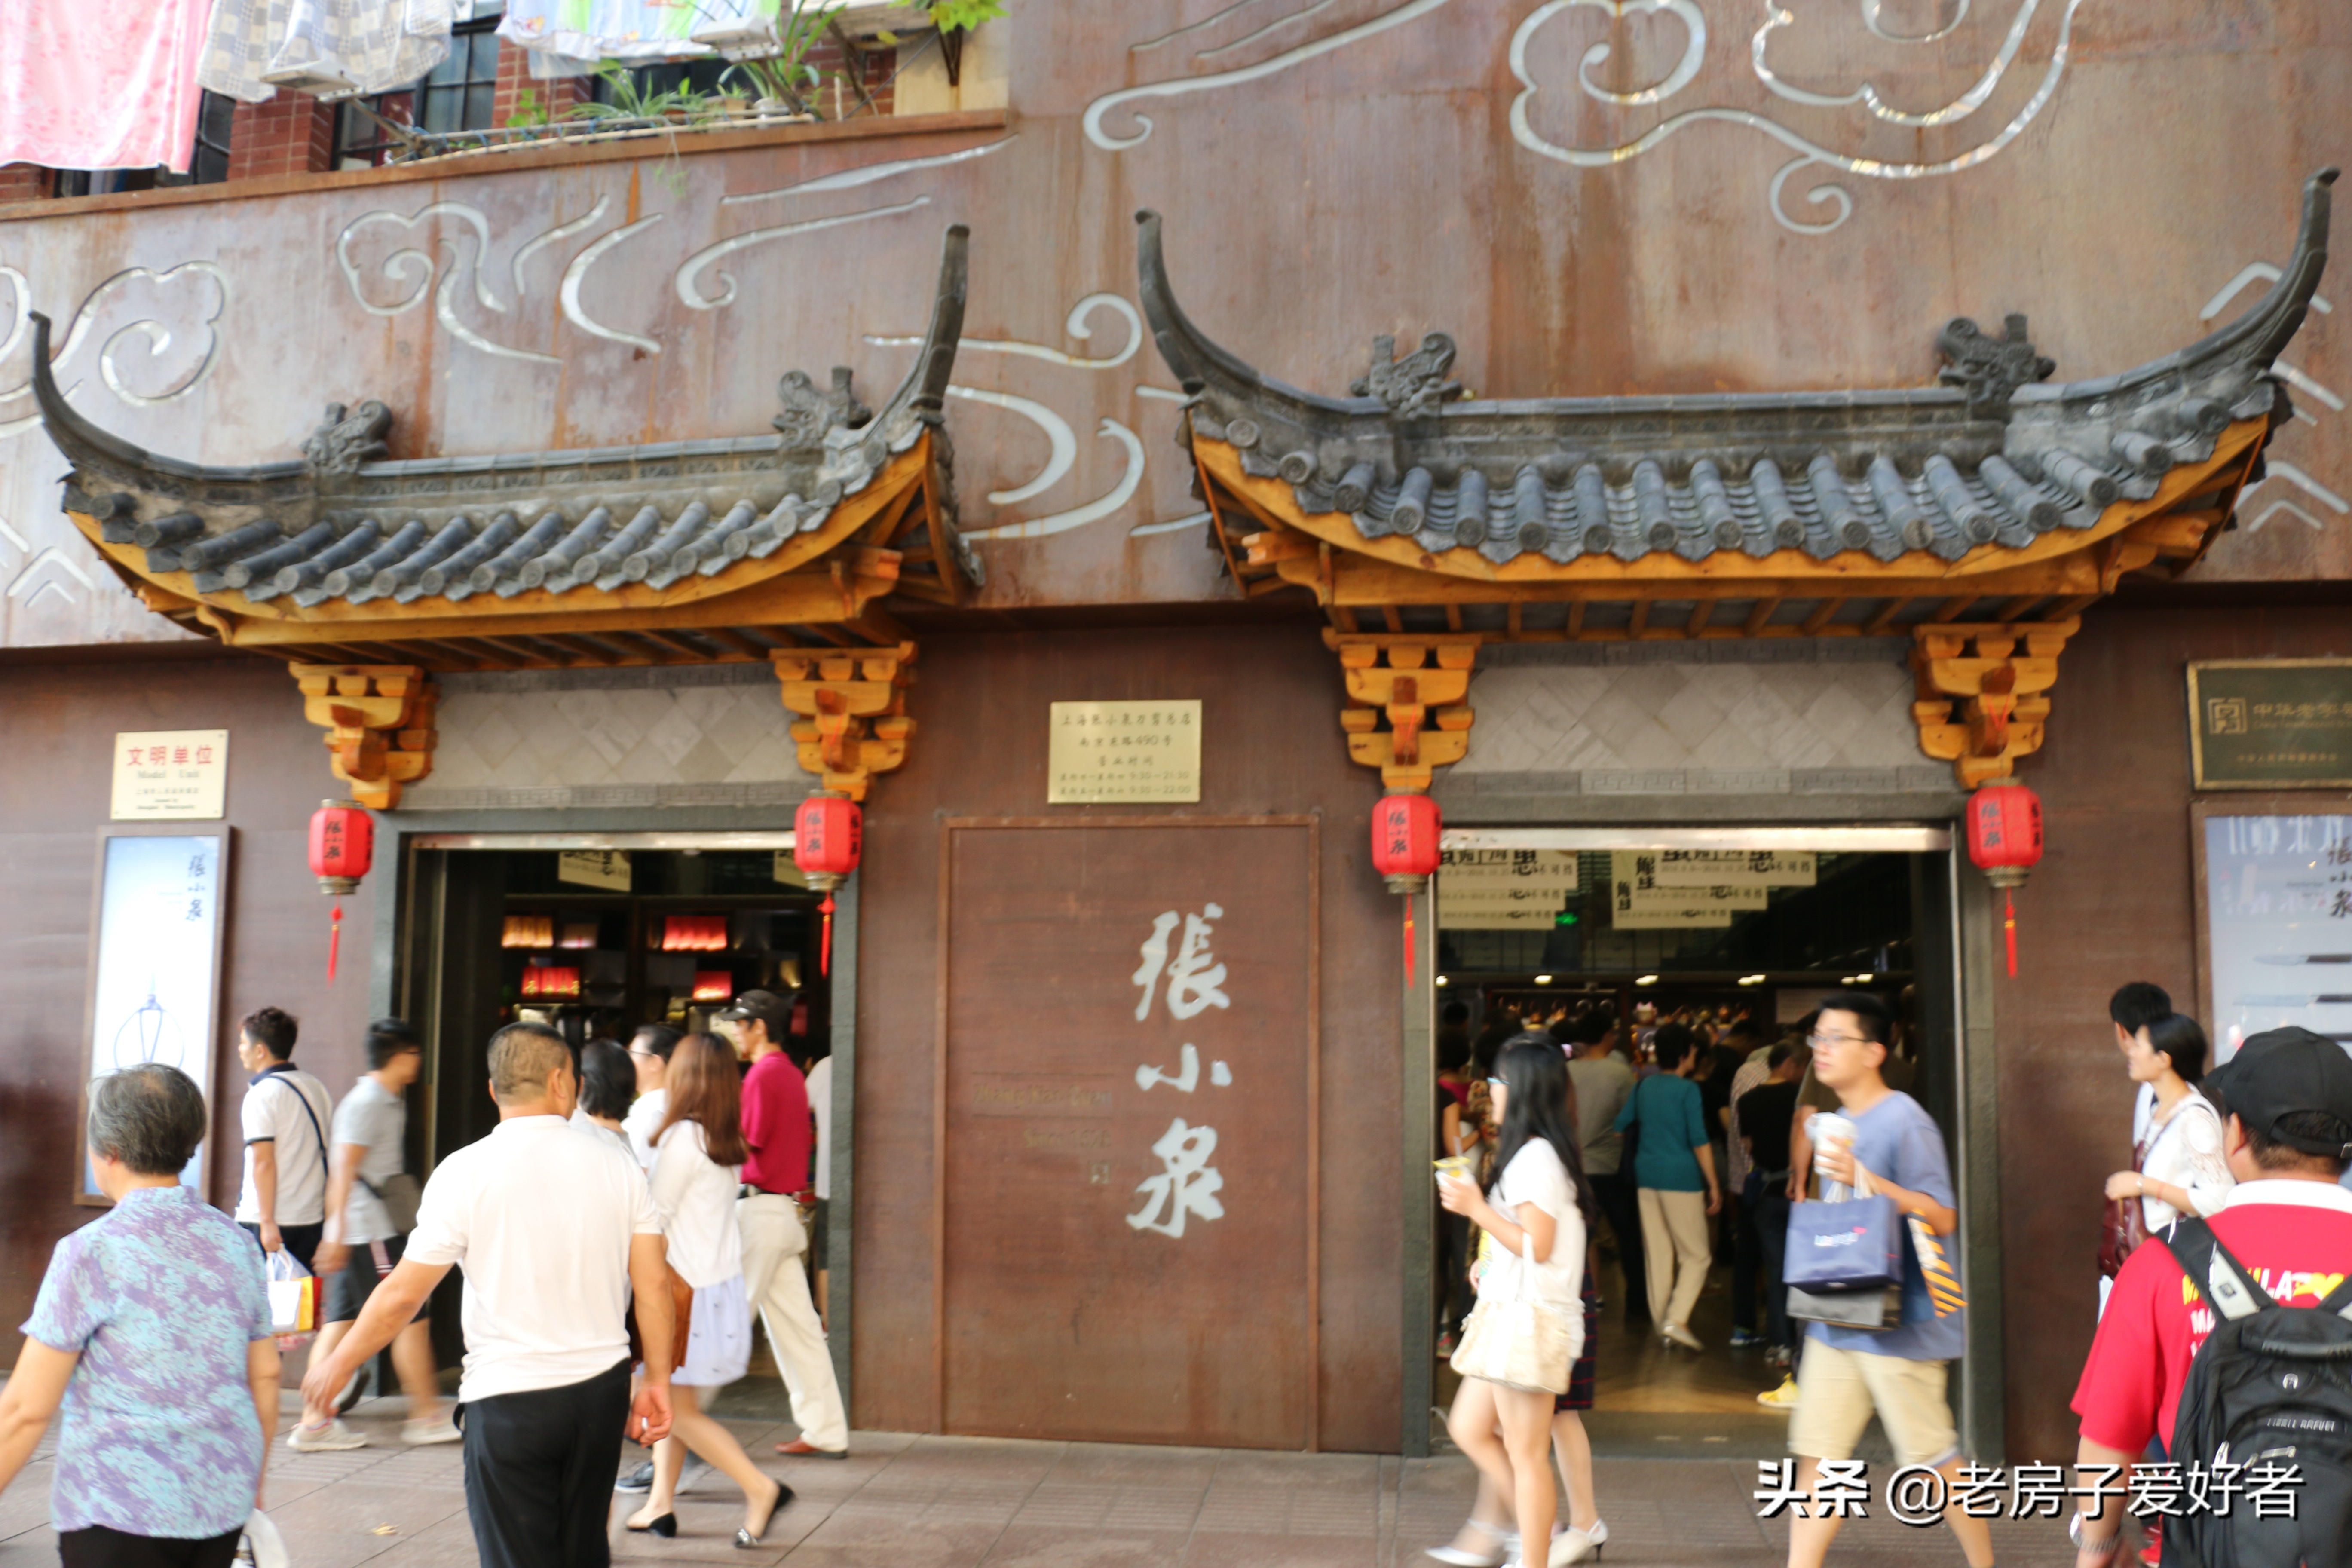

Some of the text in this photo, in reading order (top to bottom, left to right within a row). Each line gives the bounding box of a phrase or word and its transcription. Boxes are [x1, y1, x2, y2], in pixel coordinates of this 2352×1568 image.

[126, 745, 214, 766] 文明单位
[1125, 902, 1233, 1239] 張小泉
